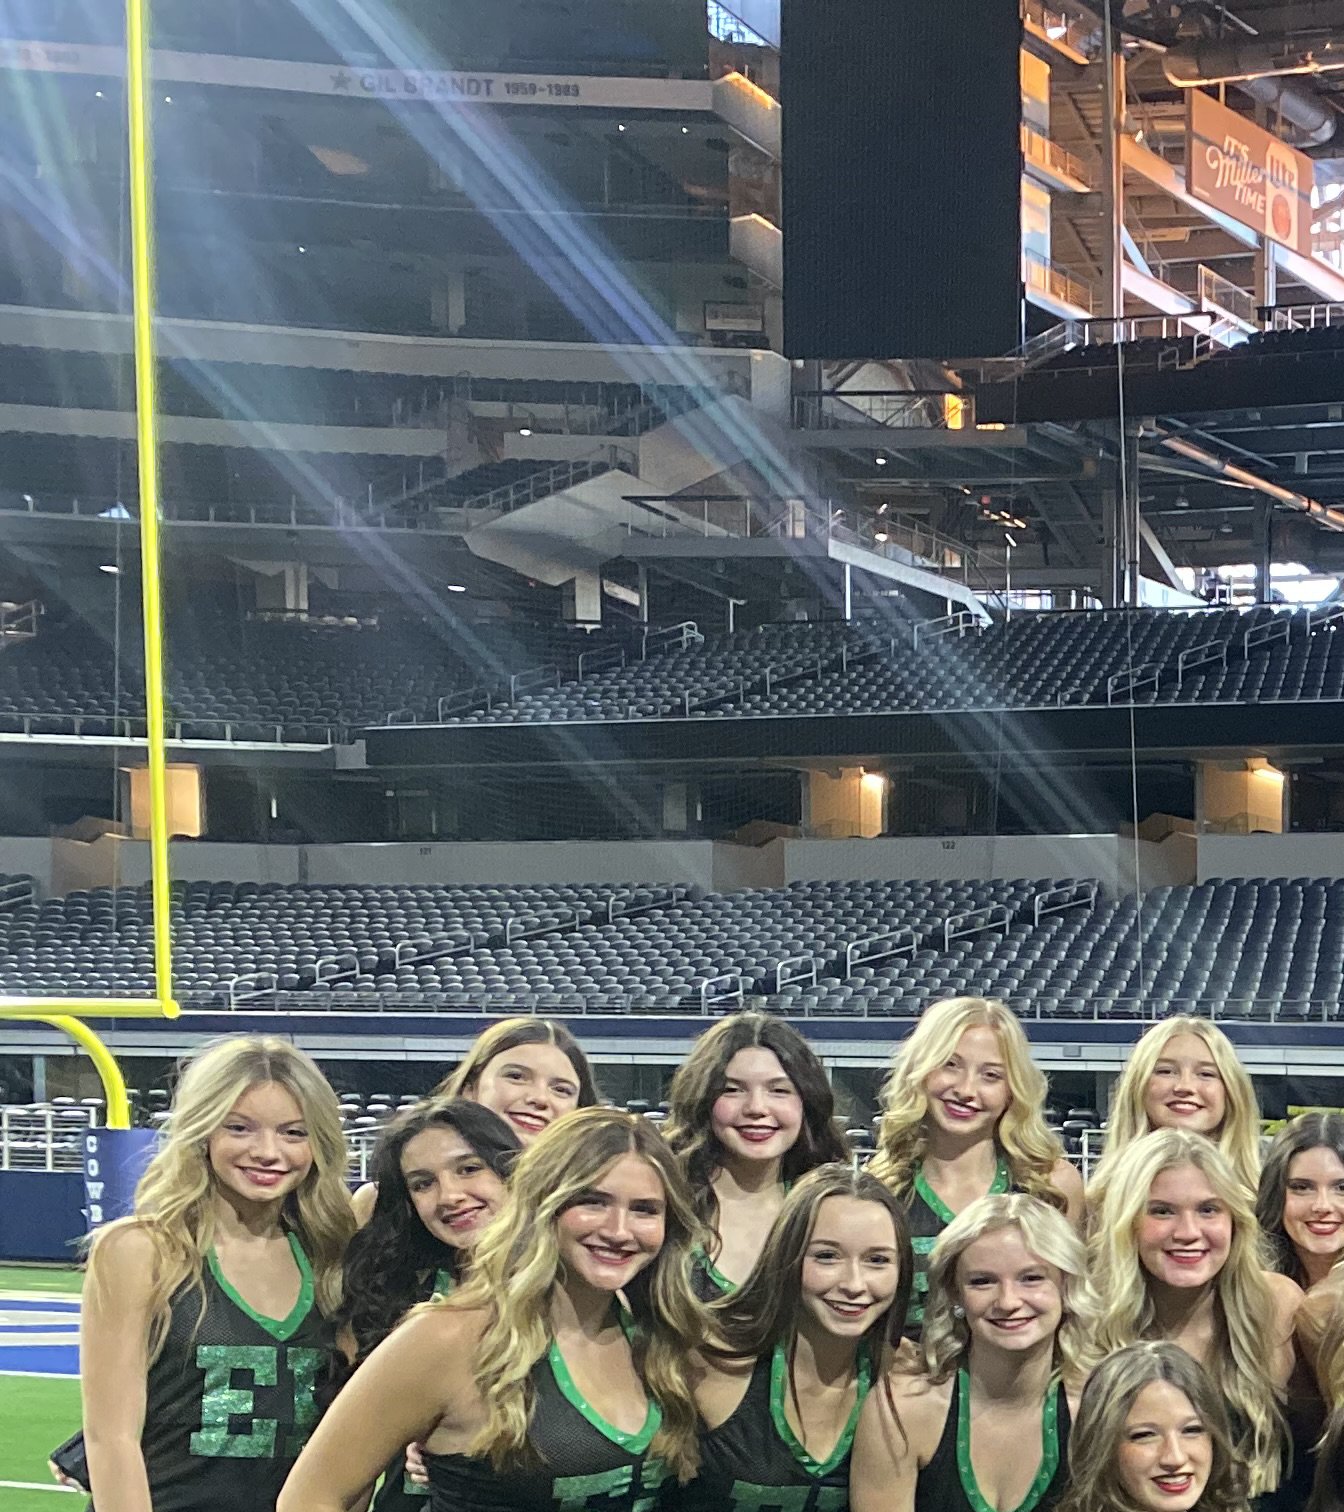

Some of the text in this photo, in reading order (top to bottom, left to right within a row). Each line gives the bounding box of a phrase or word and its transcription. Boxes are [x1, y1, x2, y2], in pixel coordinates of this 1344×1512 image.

[1223, 135, 1250, 161] IT'S
[1205, 145, 1268, 189] Miller
[1235, 183, 1267, 215] TIME
